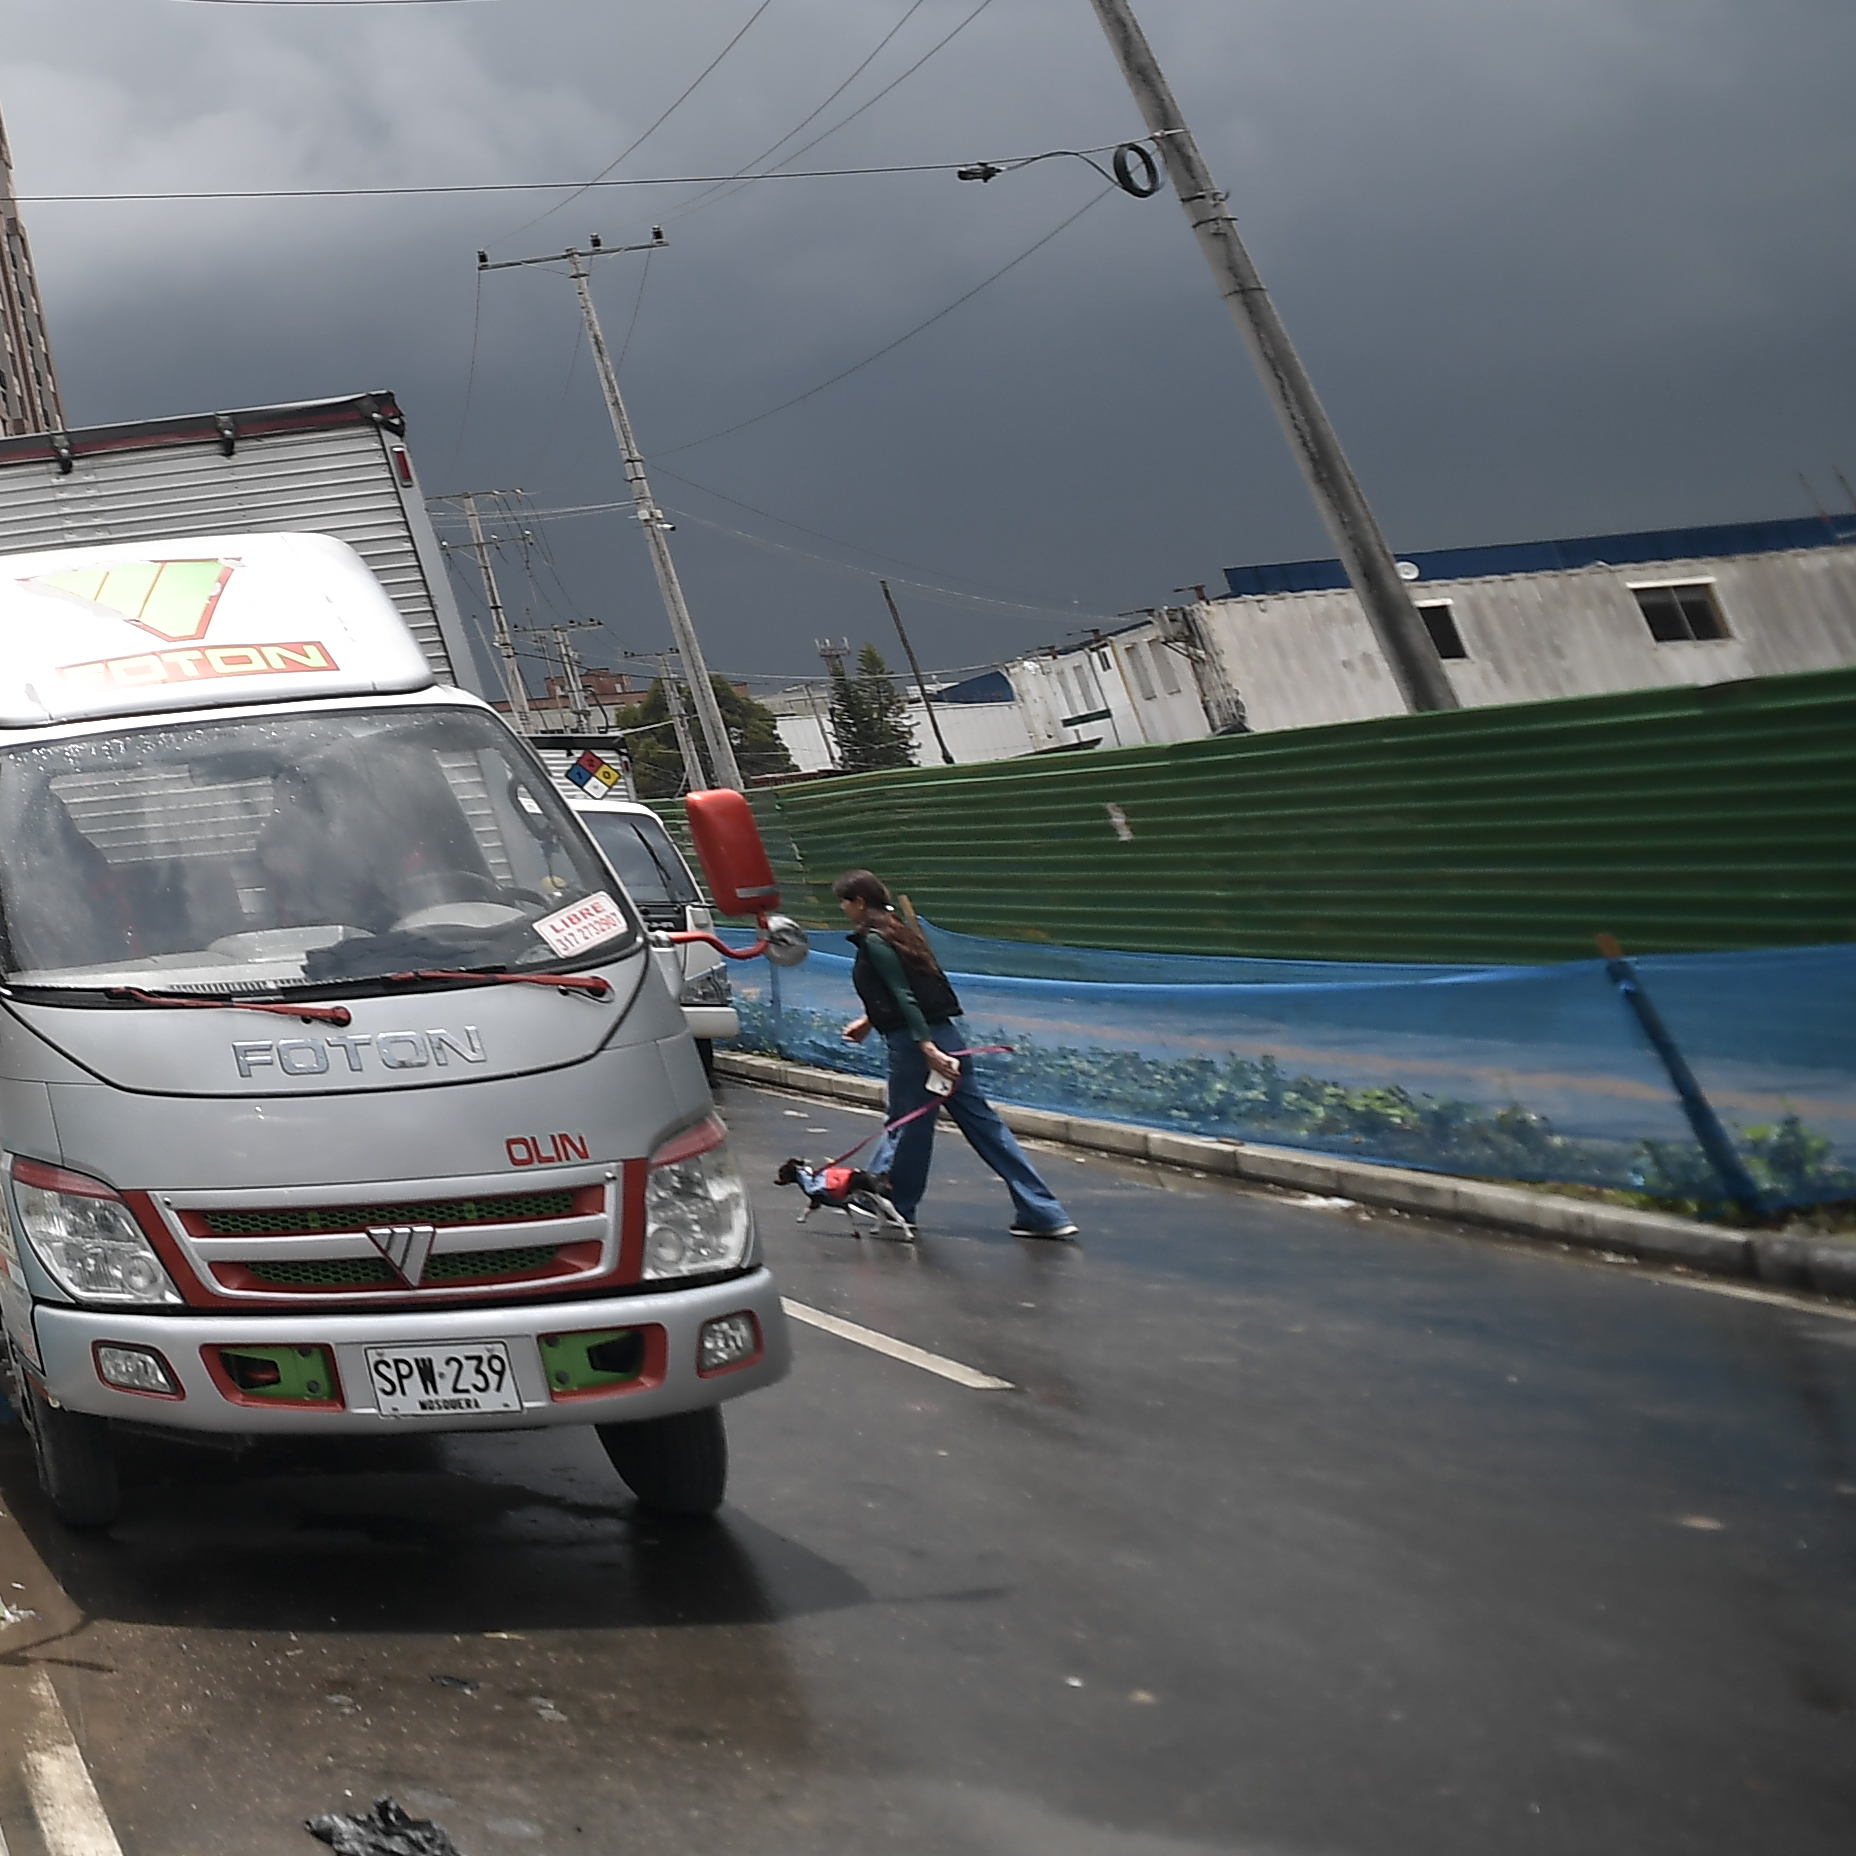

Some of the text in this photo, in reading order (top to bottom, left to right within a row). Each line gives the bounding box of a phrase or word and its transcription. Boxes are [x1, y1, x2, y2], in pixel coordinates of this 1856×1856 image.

[550, 902, 606, 934] LIBRE
[232, 1025, 487, 1078] FOTON
[505, 1132, 590, 1167] OLIN
